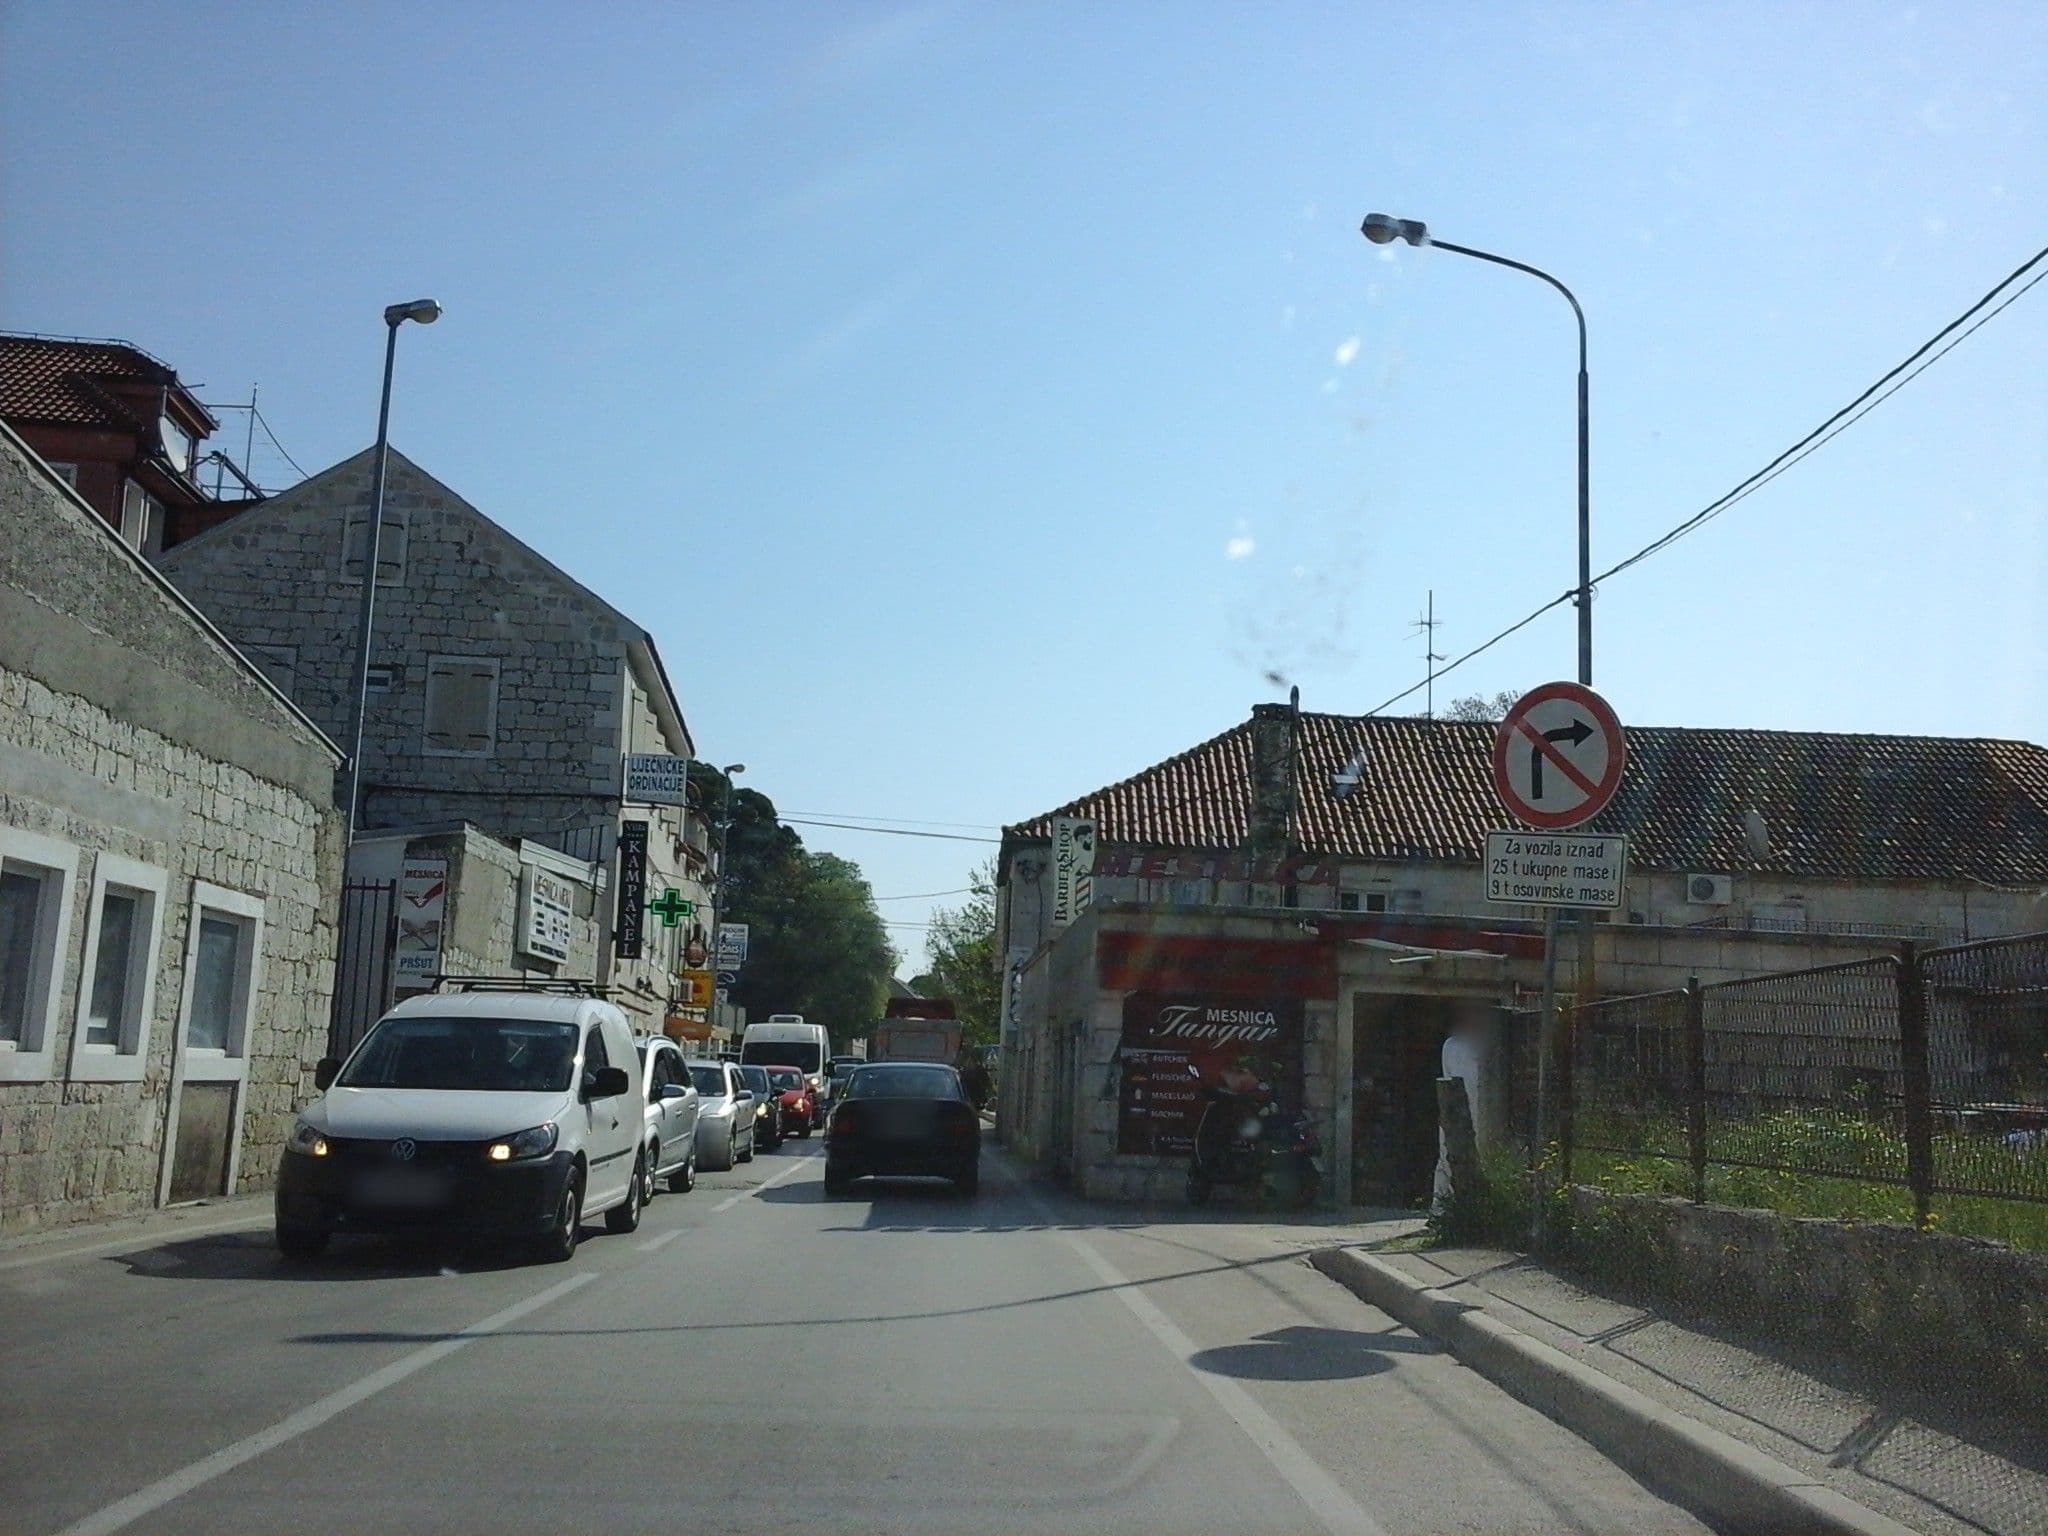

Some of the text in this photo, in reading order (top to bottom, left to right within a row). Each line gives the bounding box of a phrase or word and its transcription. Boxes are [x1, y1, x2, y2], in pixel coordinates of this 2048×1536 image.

[629, 776, 683, 792] ORDINACIJE
[1505, 838, 1604, 858] Za vozila iznad
[404, 869, 445, 879] MESNICA
[1054, 824, 1072, 921] BARBERSHOP
[1492, 859, 1616, 880] 25 t ukupne mase i
[623, 840, 641, 956] KAMPANEL
[1492, 880, 1615, 902] 9 t osovinske mase
[400, 956, 434, 969] PRŠUT
[1206, 1008, 1276, 1025] MESNICA
